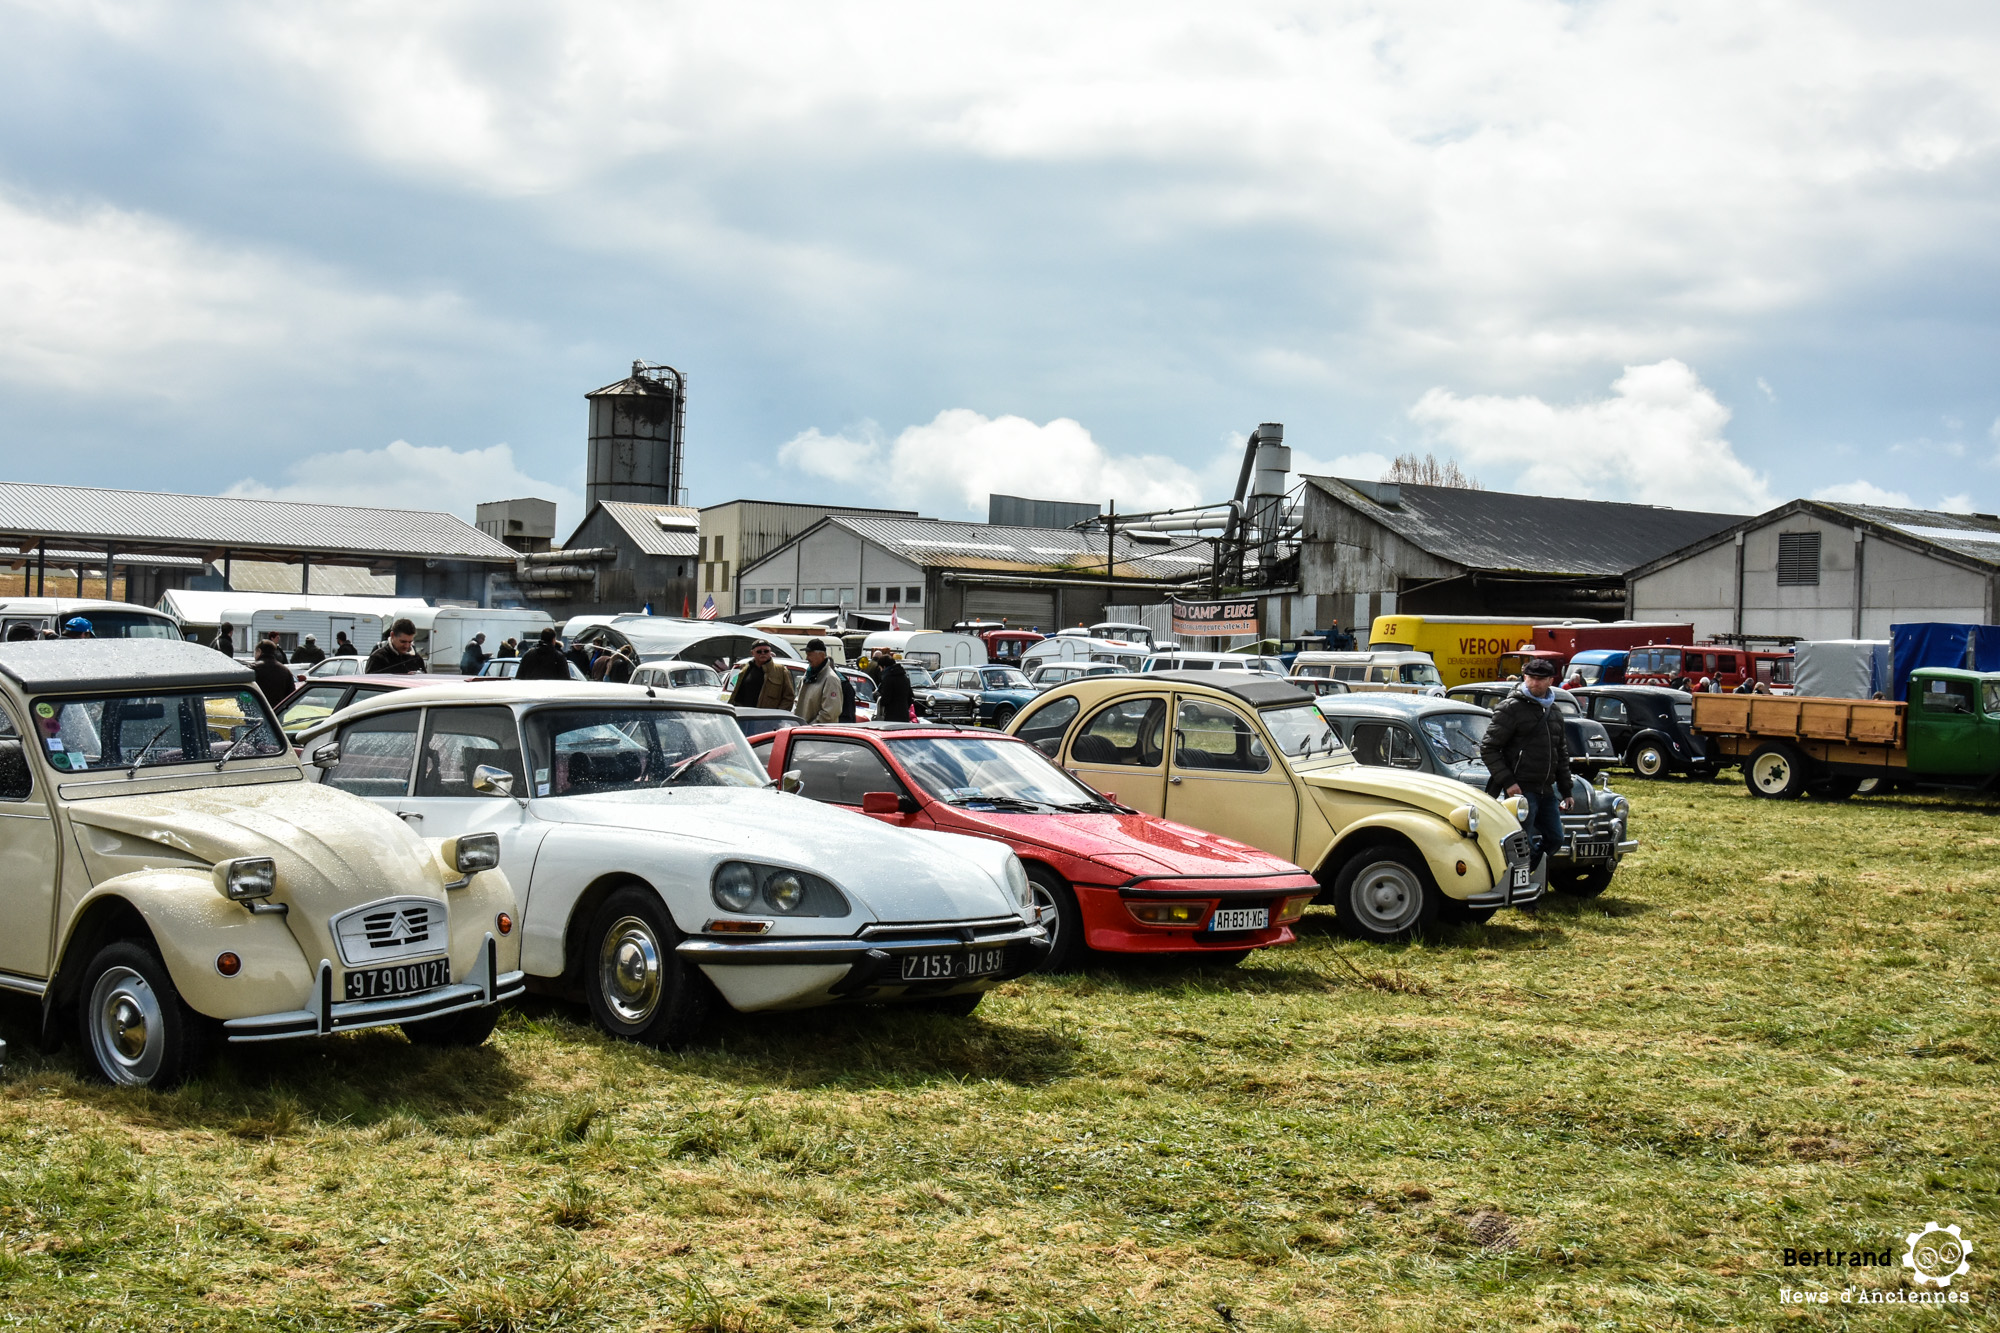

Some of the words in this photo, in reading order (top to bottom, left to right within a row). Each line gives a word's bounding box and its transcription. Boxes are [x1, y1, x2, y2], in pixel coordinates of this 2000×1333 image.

[1224, 604, 1255, 618] EURE
[1383, 623, 1397, 635] 35
[1216, 910, 1263, 928] AR-831-XG
[907, 954, 952, 976] 7153
[986, 949, 1001, 971] 93
[353, 960, 446, 997] 9790QV27
